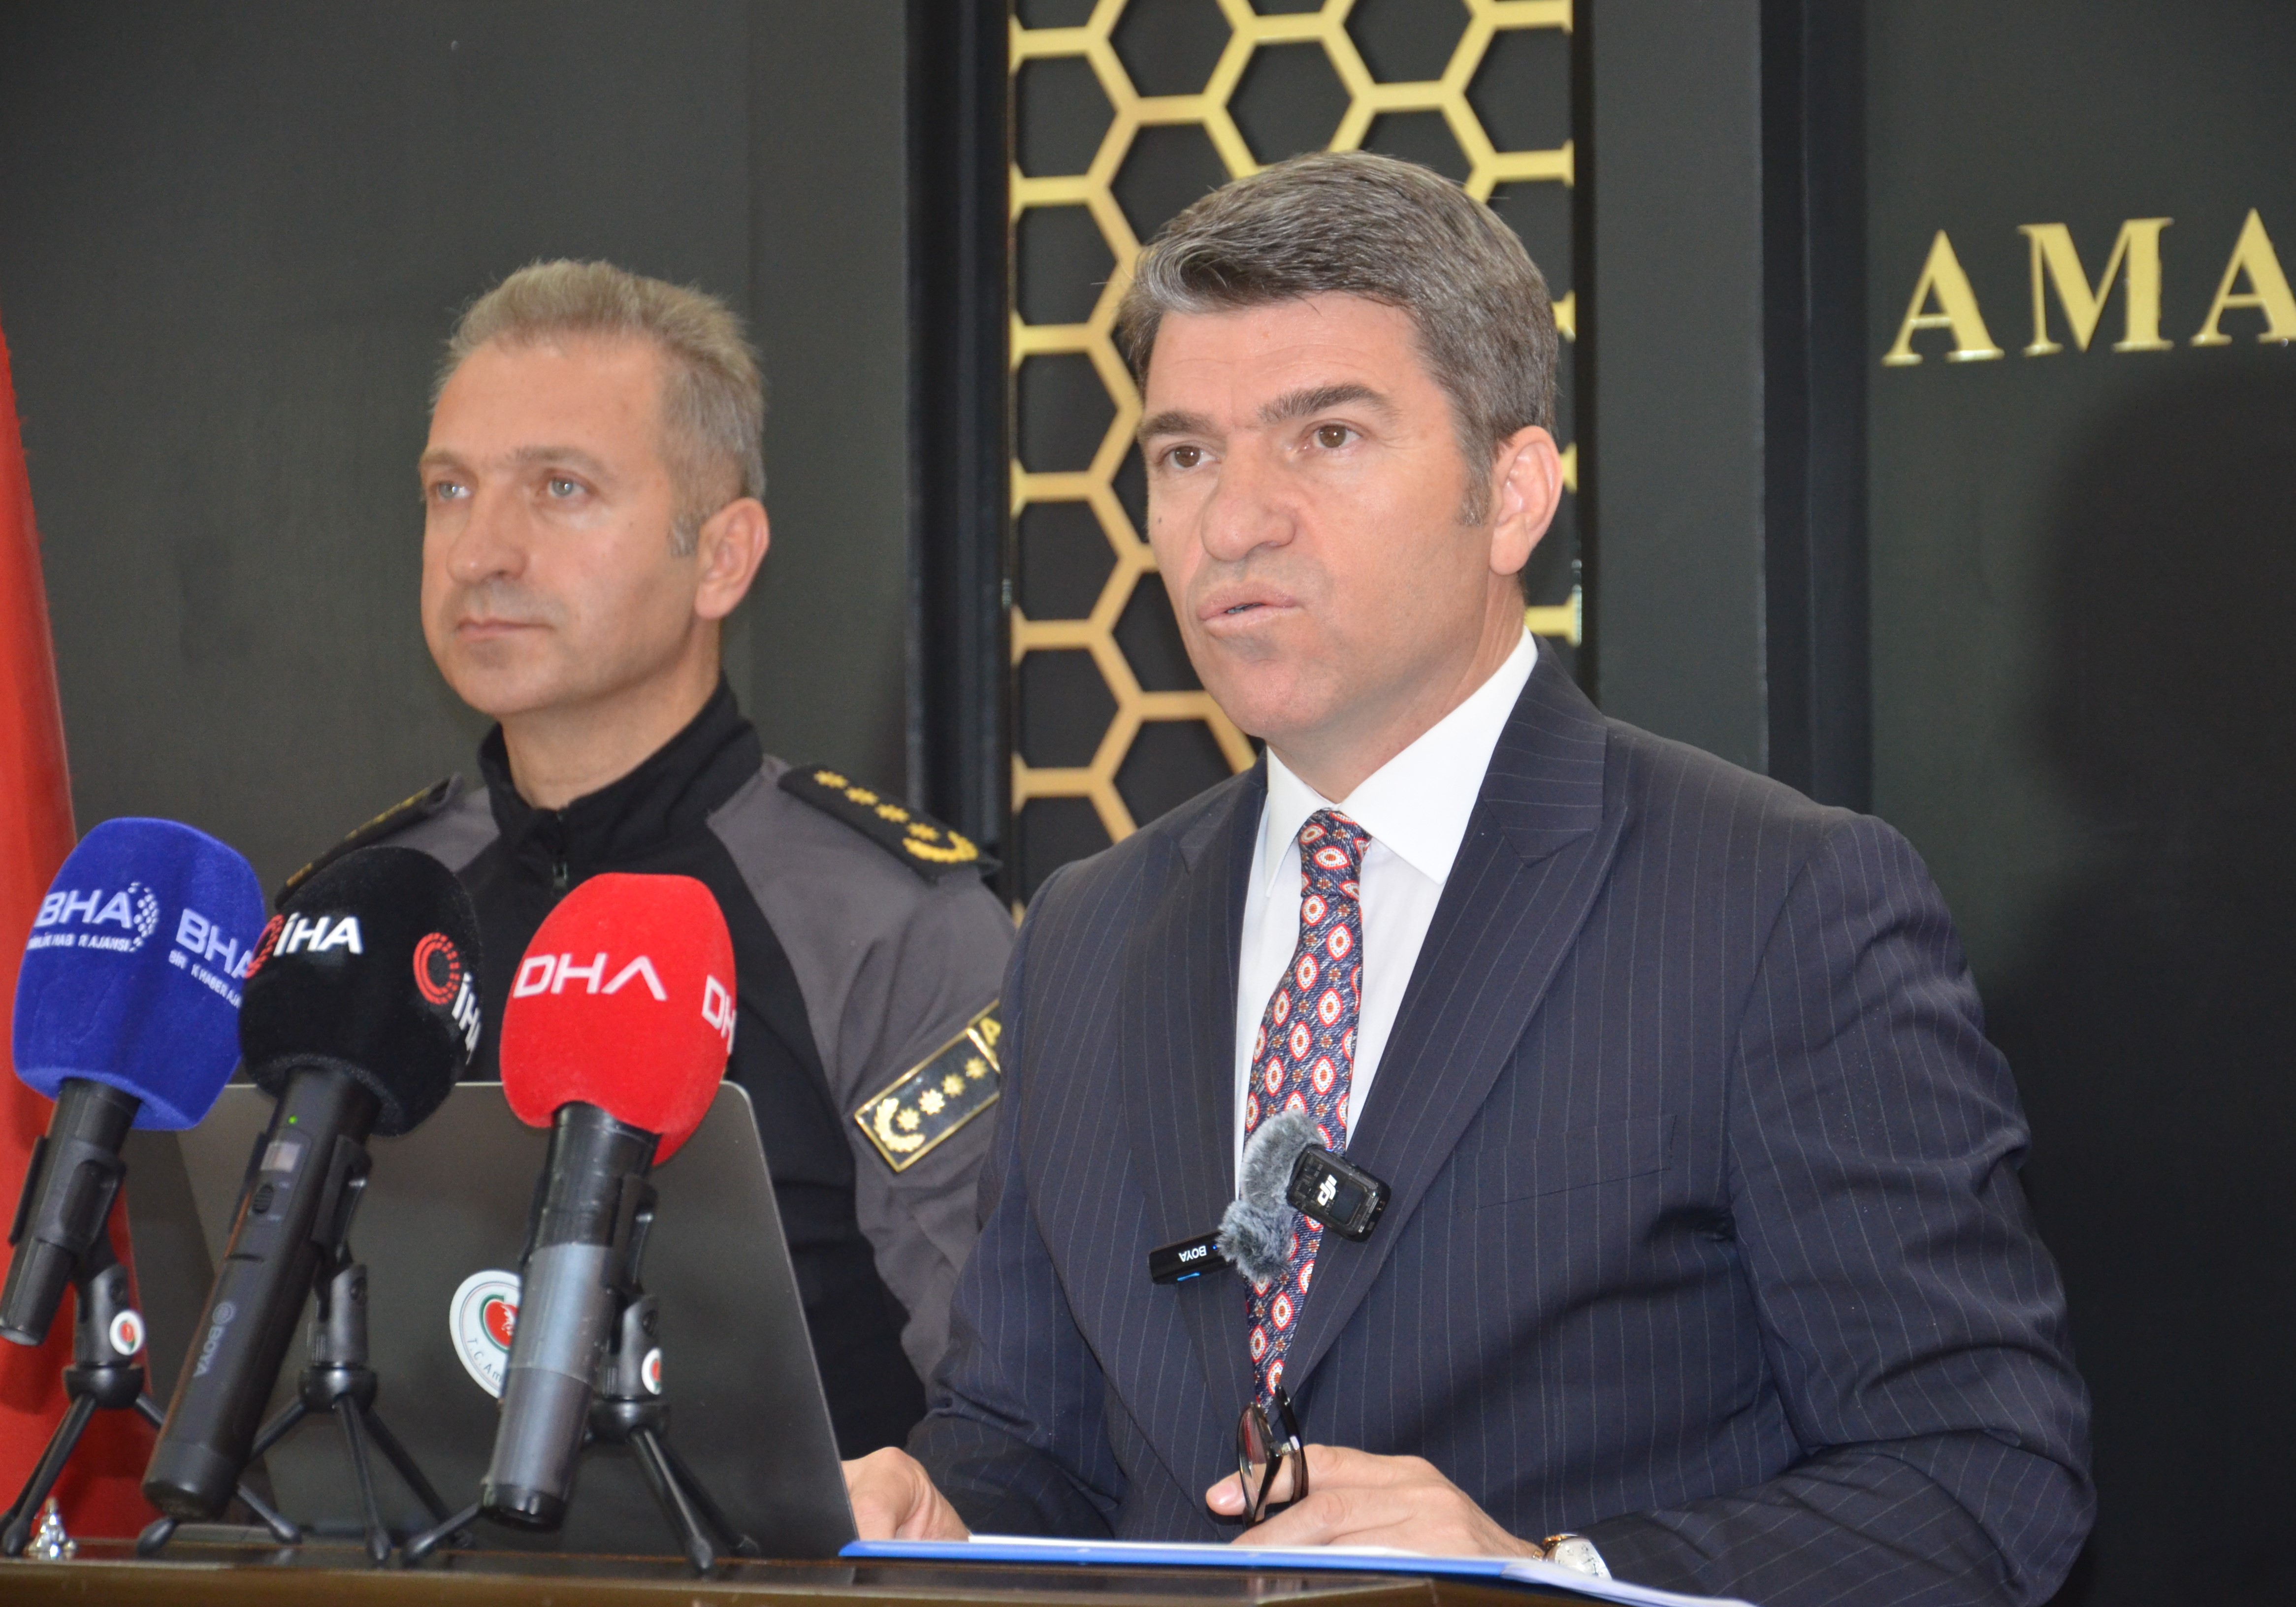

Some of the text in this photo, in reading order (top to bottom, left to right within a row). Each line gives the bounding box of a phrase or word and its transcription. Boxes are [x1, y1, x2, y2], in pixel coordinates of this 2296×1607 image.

[1881, 207, 2296, 367] AMA
[33, 888, 132, 929] BHA
[273, 911, 363, 957] İHA
[513, 952, 668, 1001] DHA
[1178, 1245, 1207, 1262] BOYA
